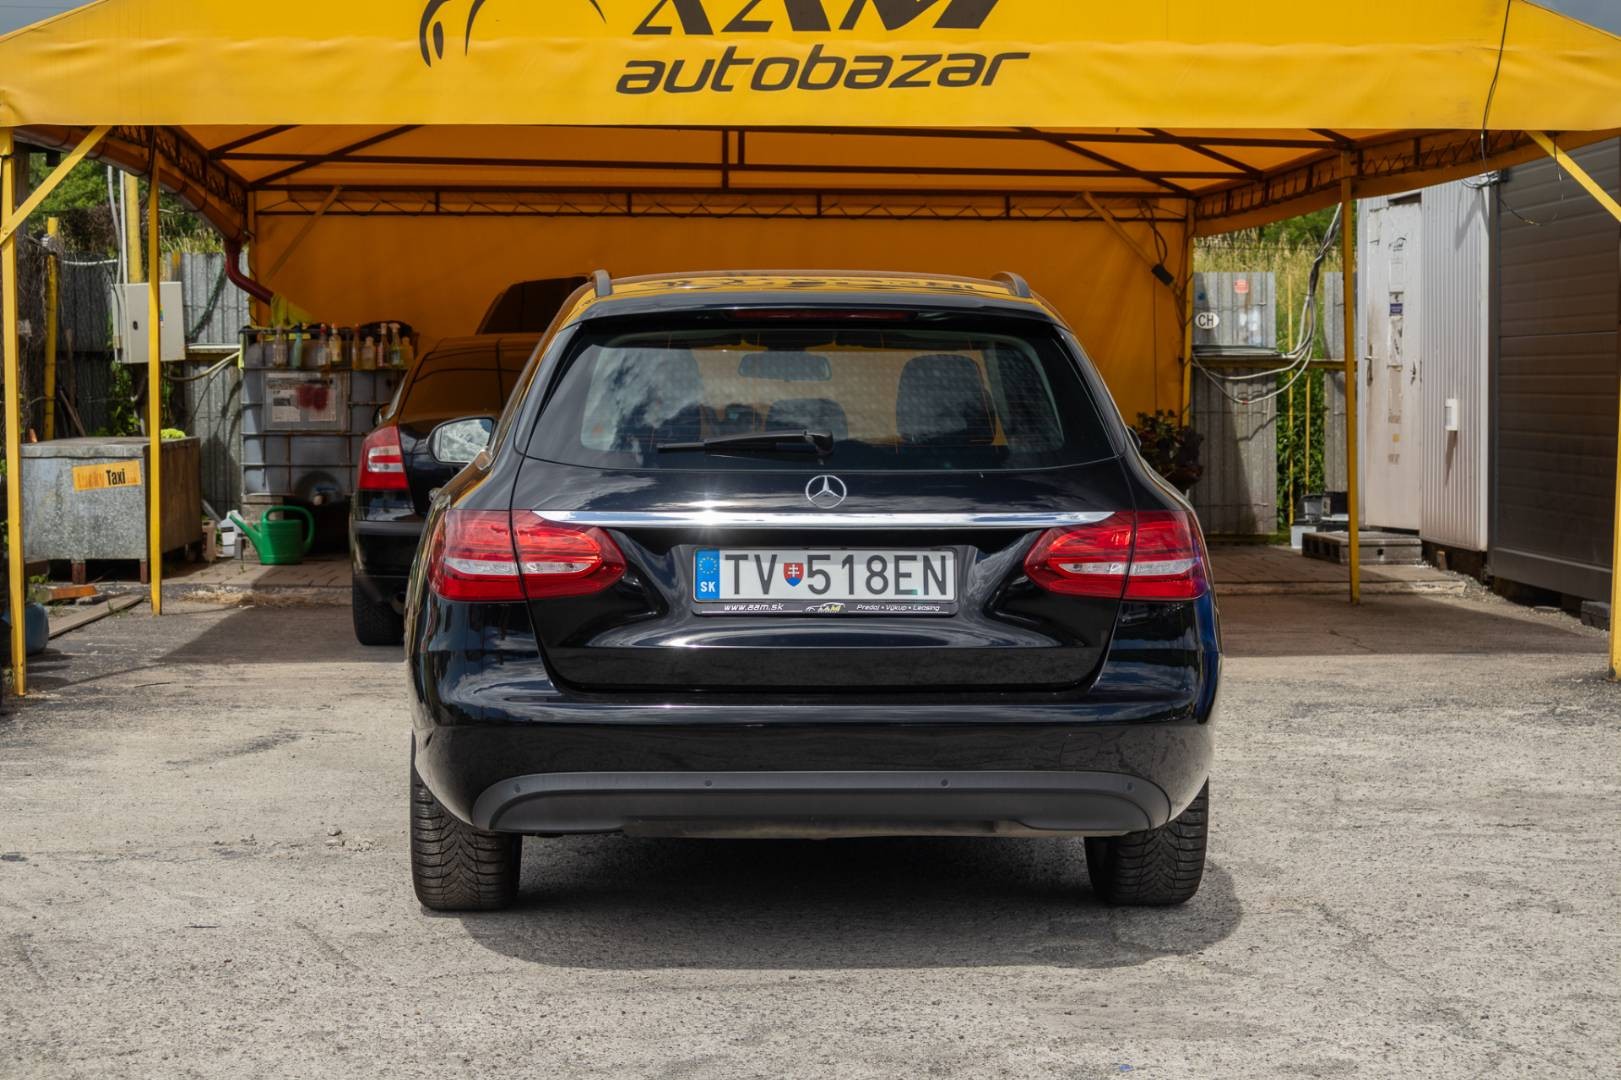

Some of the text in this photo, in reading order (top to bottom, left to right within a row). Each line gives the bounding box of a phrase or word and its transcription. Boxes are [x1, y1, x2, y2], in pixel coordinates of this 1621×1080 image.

[616, 44, 1030, 94] autobazar
[1198, 314, 1214, 327] CH
[106, 468, 126, 485] Taxi
[700, 581, 716, 593] SK
[724, 603, 784, 611] www.aam.sk
